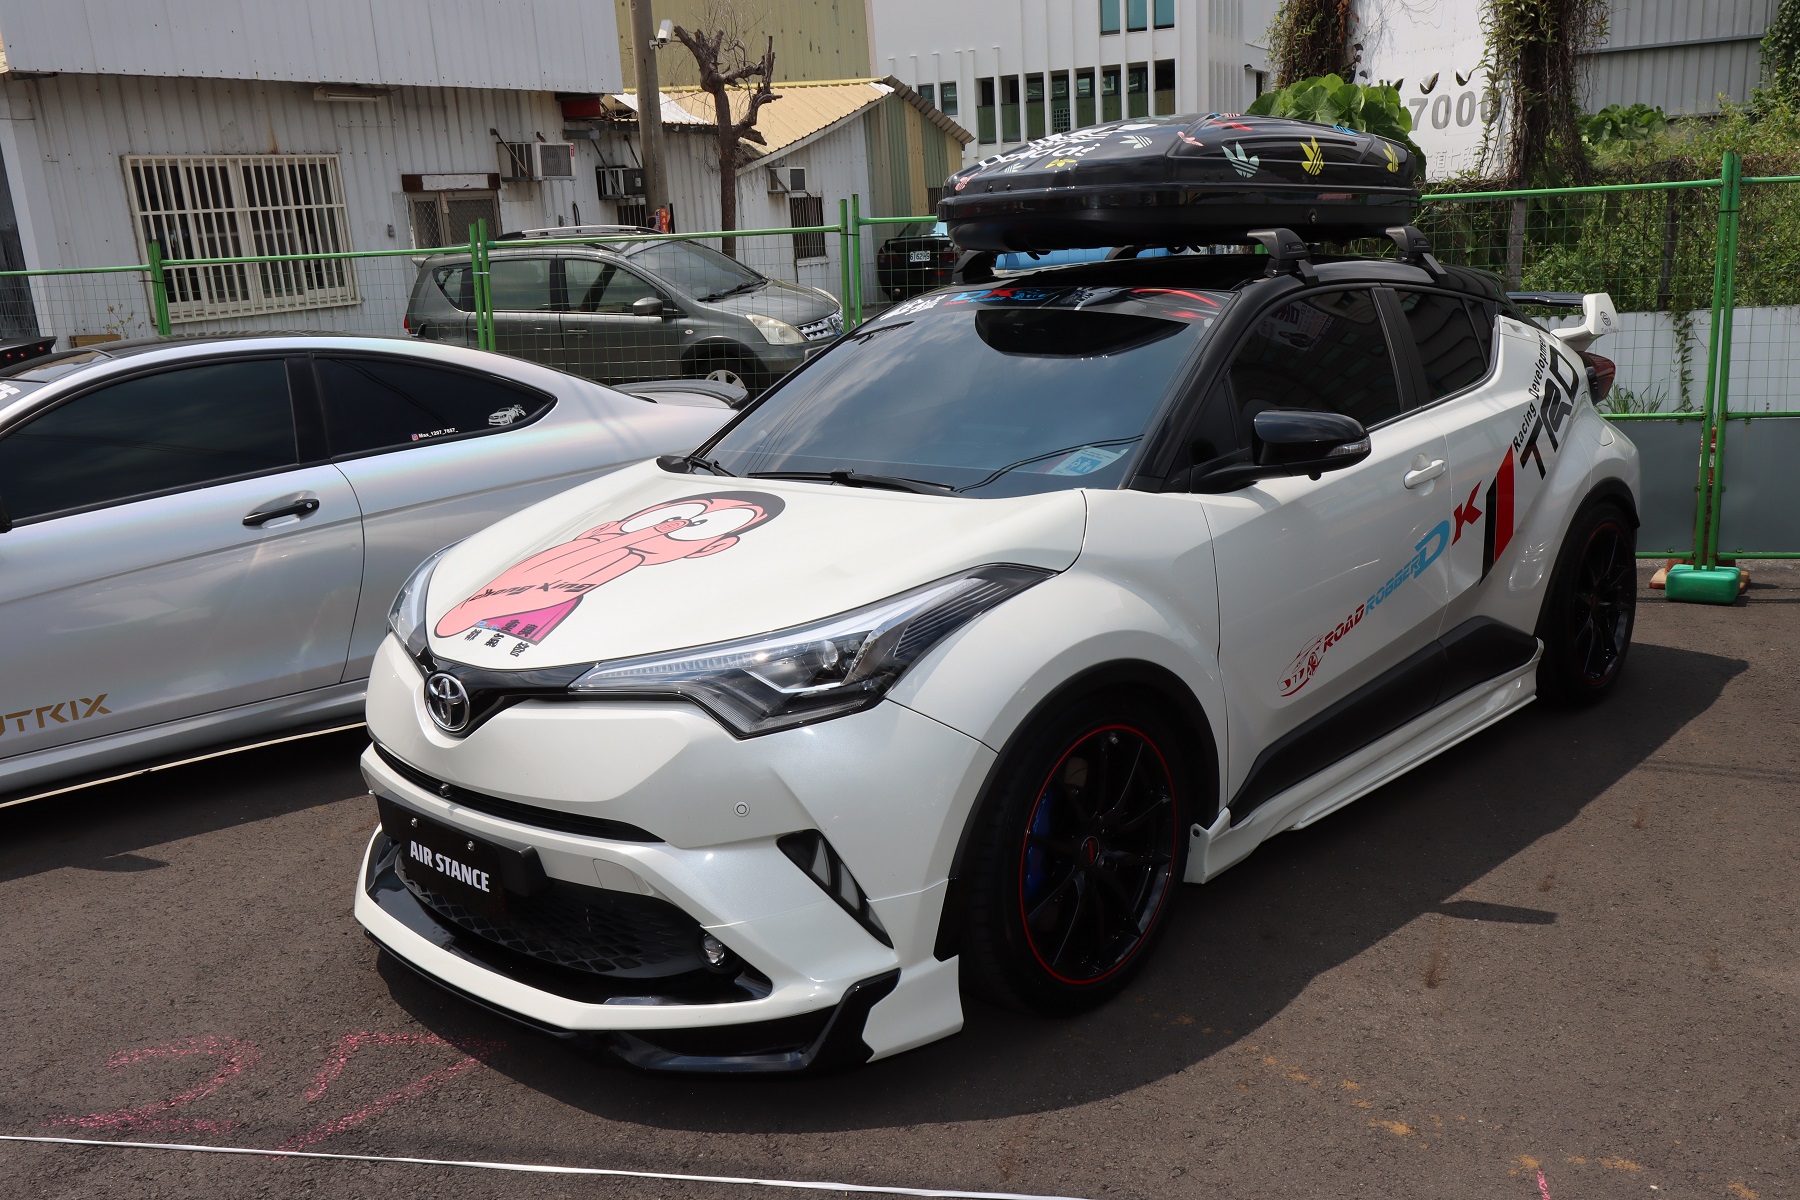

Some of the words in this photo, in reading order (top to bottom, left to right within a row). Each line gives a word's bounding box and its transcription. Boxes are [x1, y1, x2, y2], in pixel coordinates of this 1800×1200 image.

[1409, 91, 1501, 131] 7000
[1512, 402, 1538, 453] Racing
[1520, 344, 1580, 481] TRD
[410, 840, 433, 867] AIR
[435, 853, 490, 892] STANCE
